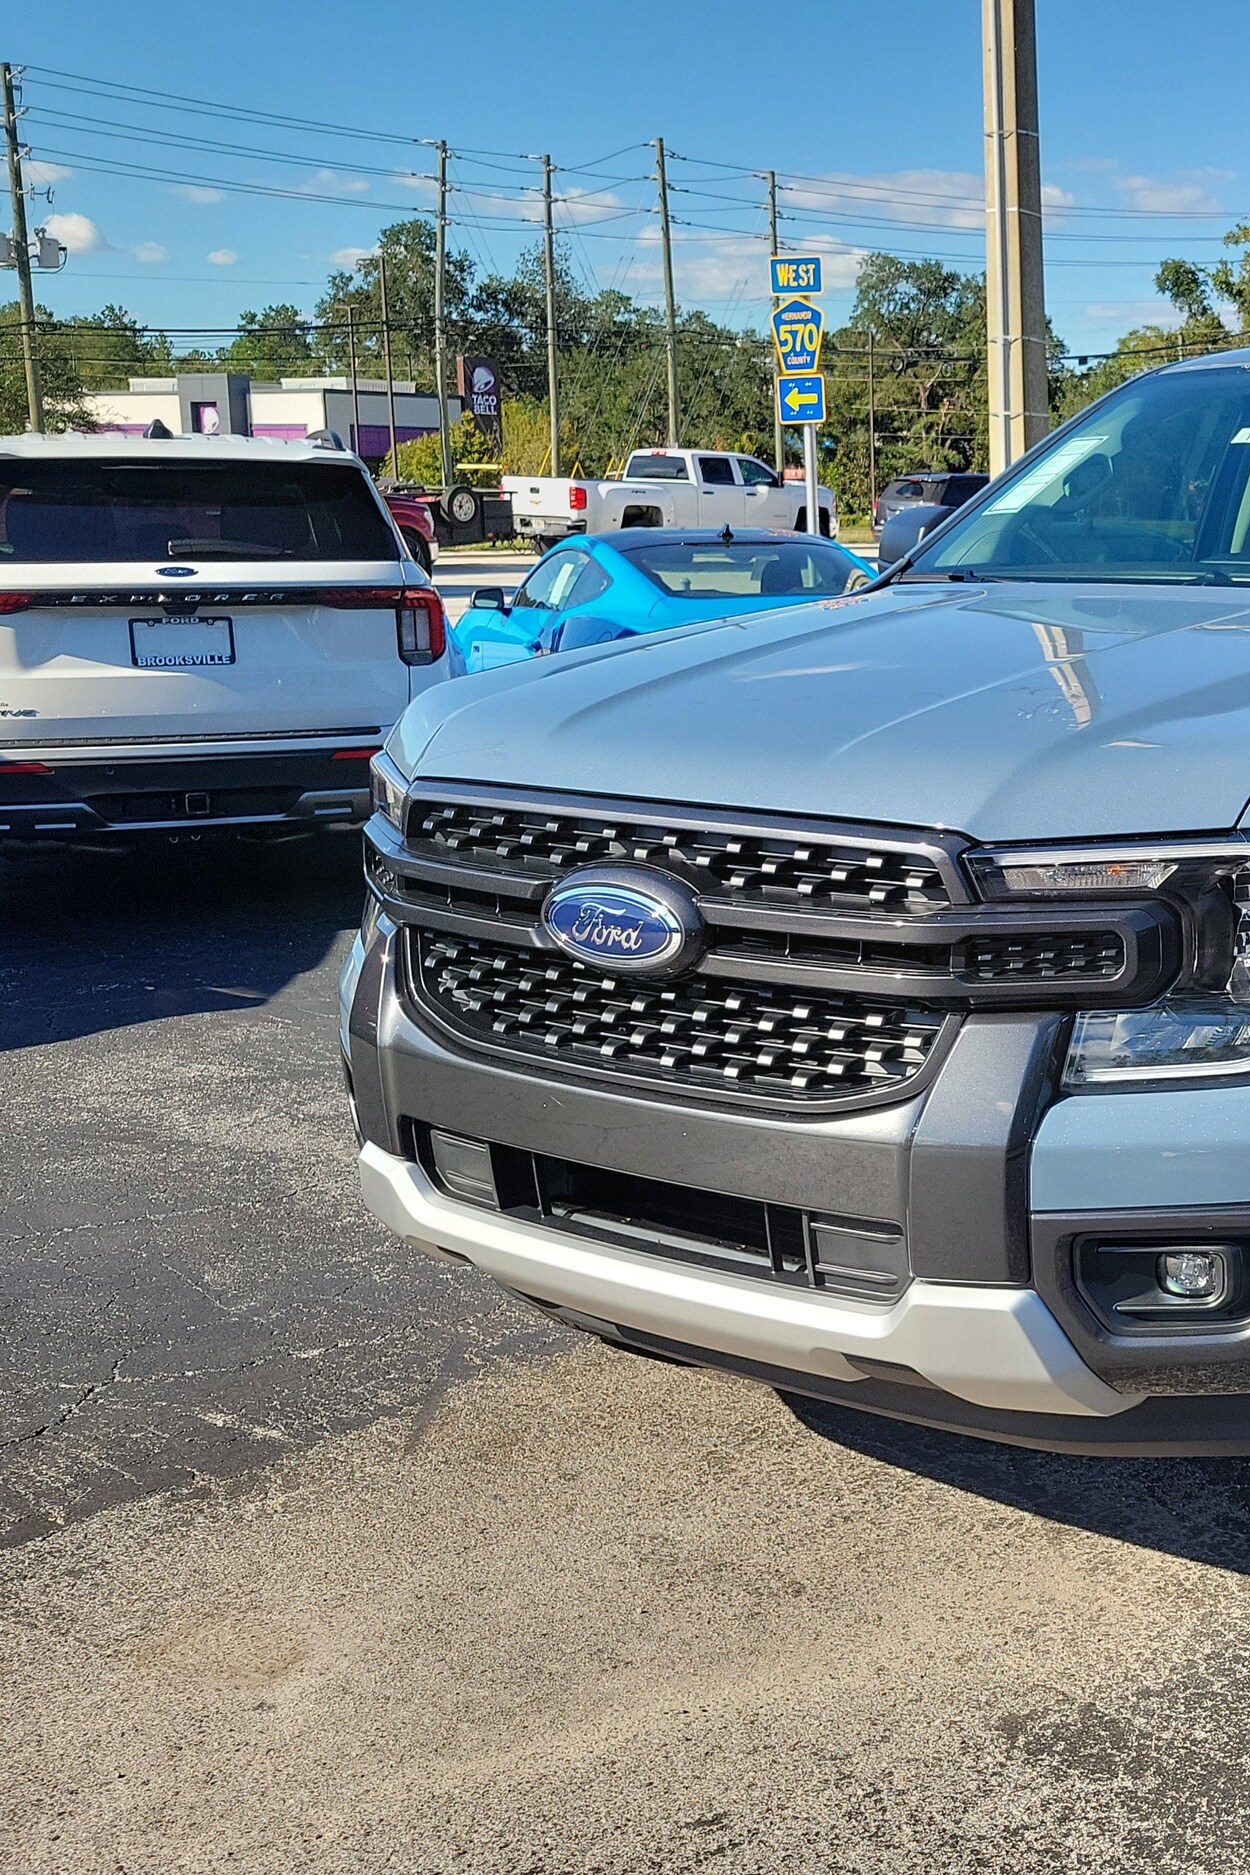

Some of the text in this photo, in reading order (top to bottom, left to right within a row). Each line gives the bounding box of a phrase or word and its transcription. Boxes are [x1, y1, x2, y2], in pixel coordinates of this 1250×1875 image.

[776, 263, 815, 286] WEST
[779, 322, 818, 353] 570
[471, 394, 497, 406] TACO
[474, 404, 497, 415] BELL
[161, 617, 200, 625] FORD
[137, 654, 231, 667] BROOKSVILLE
[570, 902, 643, 950] Ford
